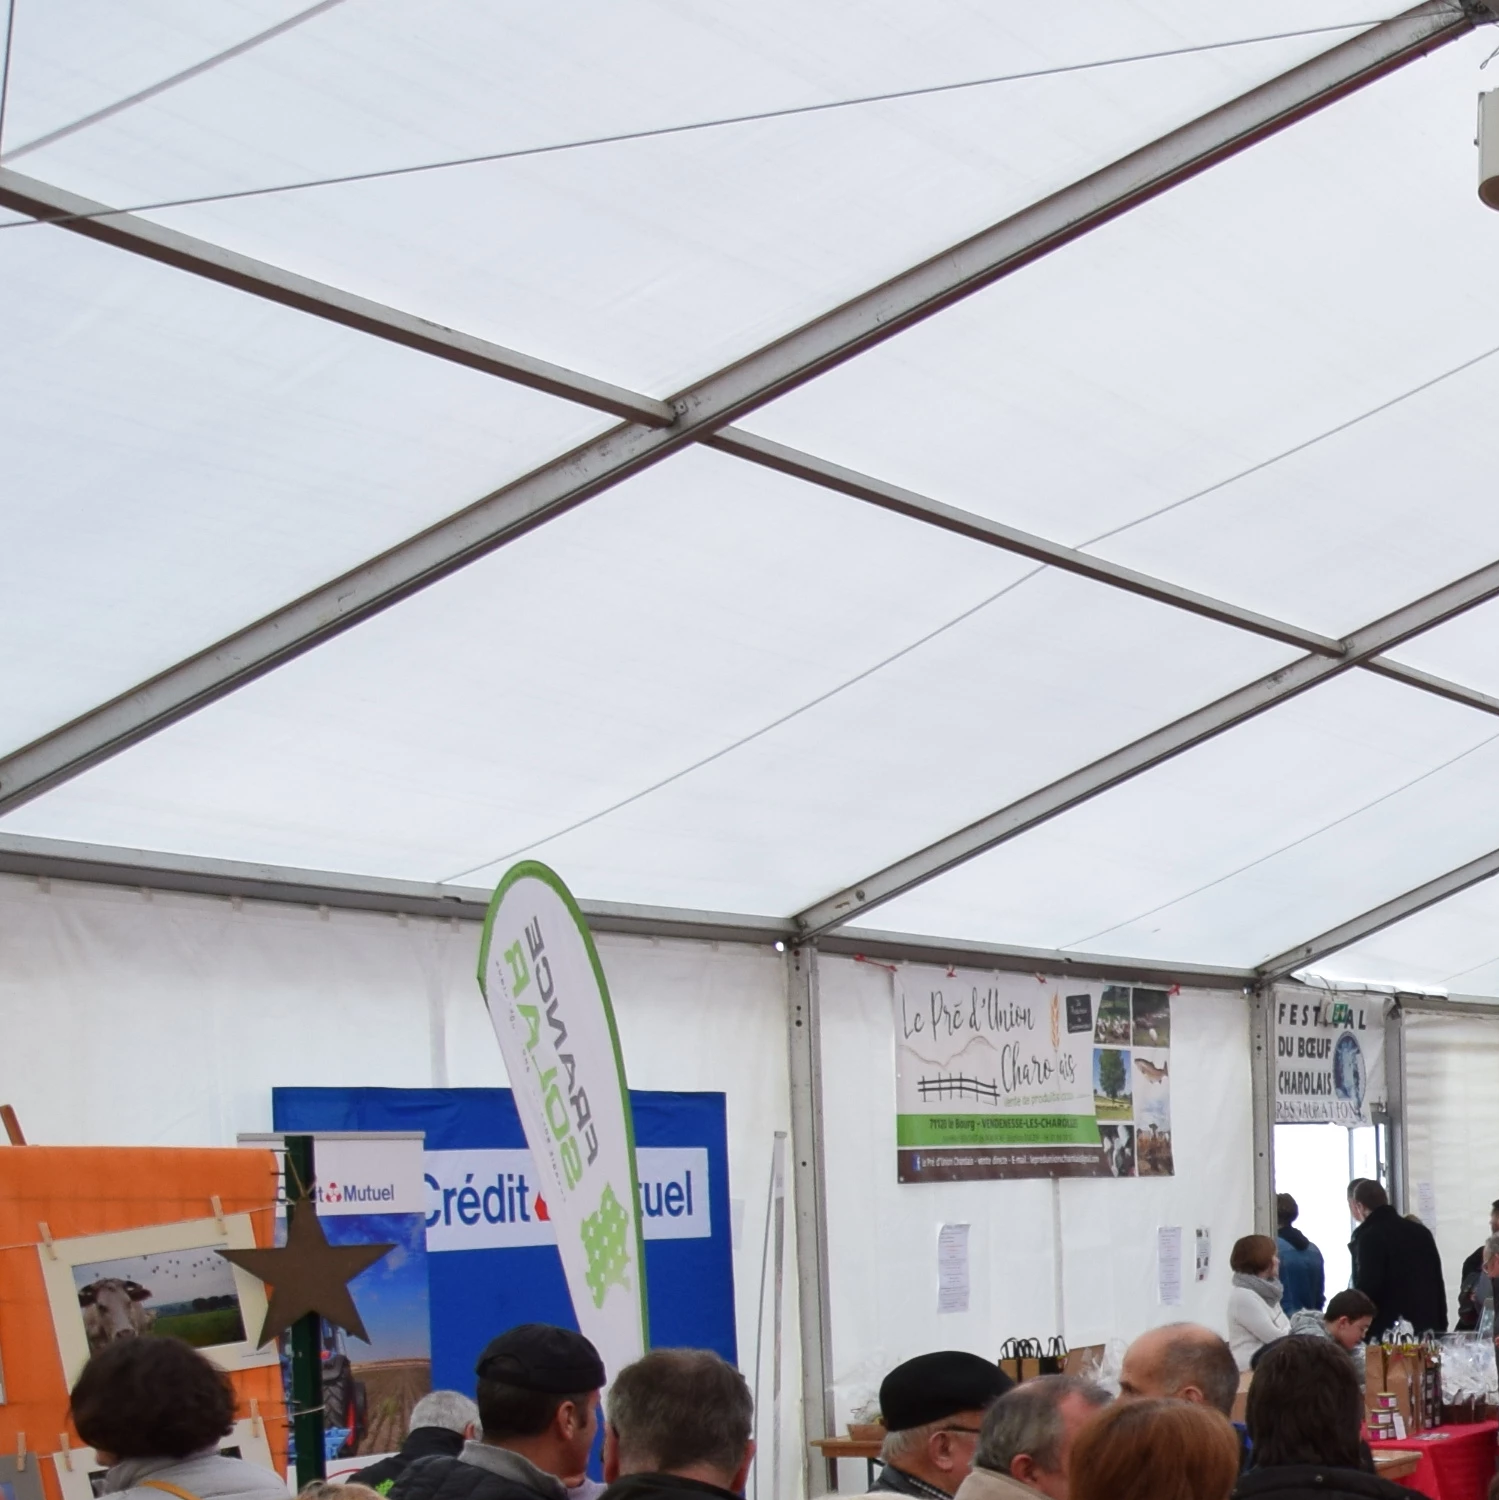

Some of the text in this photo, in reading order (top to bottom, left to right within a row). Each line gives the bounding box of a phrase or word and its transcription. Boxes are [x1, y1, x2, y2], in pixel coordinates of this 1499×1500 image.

[902, 991, 925, 1040] Le
[930, 990, 964, 1041] Pré
[1278, 1003, 1367, 1030] FESTAL
[1278, 1035, 1332, 1059] DU BŒUF
[1278, 1071, 1332, 1095] CHAROLAIS
[343, 1184, 394, 1204] Mutuel
[424, 1170, 693, 1228] Crédit uel
